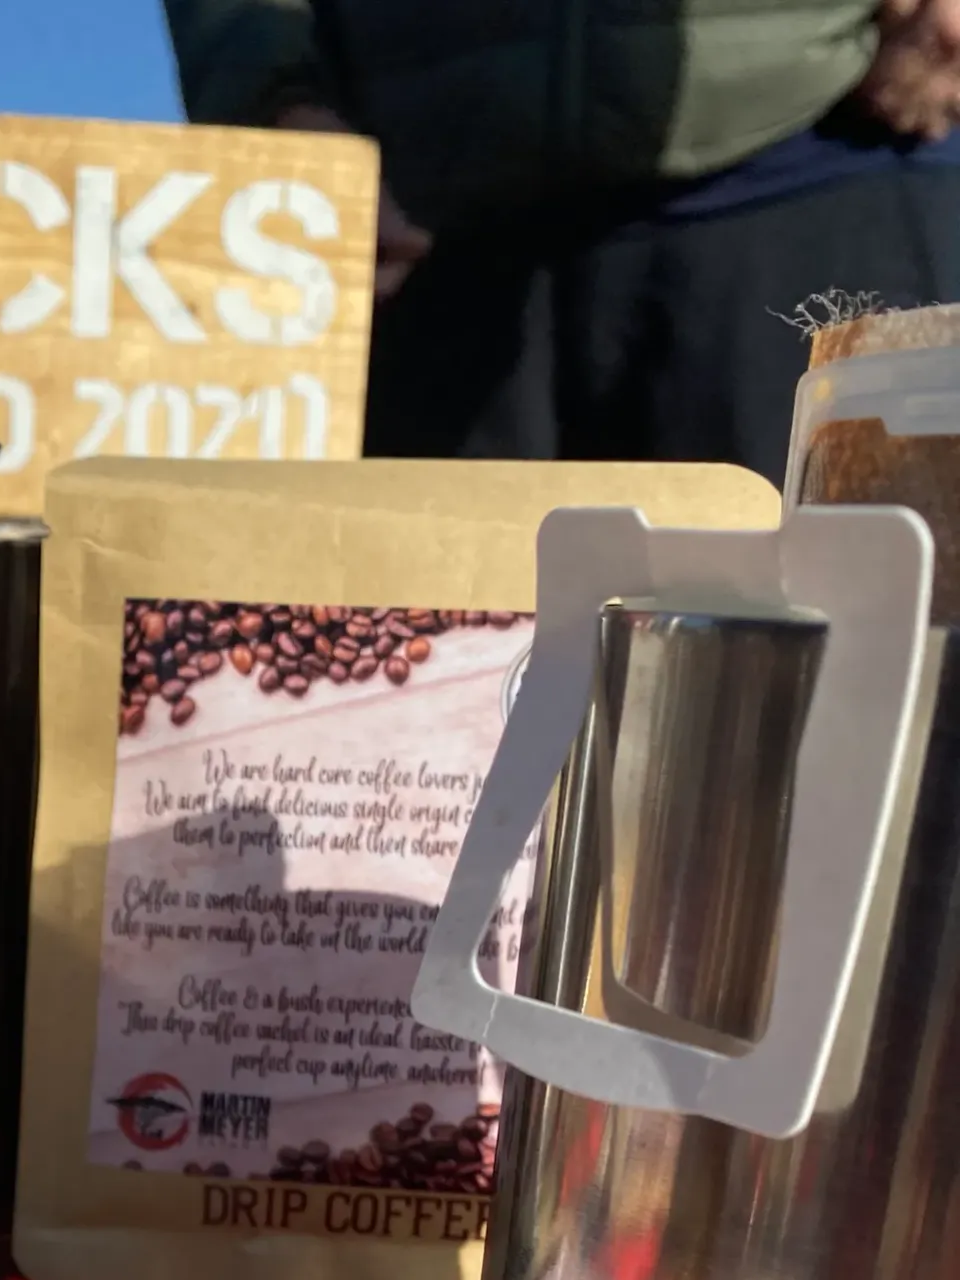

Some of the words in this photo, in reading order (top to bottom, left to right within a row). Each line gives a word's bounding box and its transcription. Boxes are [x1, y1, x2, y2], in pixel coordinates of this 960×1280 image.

[202, 748, 235, 785] We
[242, 763, 268, 782] are
[273, 754, 317, 785] hard
[319, 767, 351, 786] core
[358, 758, 412, 795] coffee
[418, 760, 469, 791] lovers
[144, 779, 173, 816] We
[274, 787, 347, 818] delicious
[353, 794, 404, 834] single
[409, 804, 460, 834] origin
[173, 816, 215, 849] them
[219, 817, 235, 845] to
[238, 818, 326, 857] perfection
[329, 824, 363, 855] and
[366, 824, 407, 857] then
[411, 827, 458, 857] share
[123, 875, 180, 913] Coffee
[185, 890, 201, 909] is
[205, 883, 290, 927] something
[295, 887, 333, 918] that
[336, 900, 379, 929] gives
[384, 902, 415, 933] you
[178, 973, 237, 1012] Coffee
[199, 1010, 250, 1046] coffee
[201, 1091, 271, 1117] MARTIN
[198, 1114, 269, 1140] MEYER
[201, 1184, 308, 1229] DRIP
